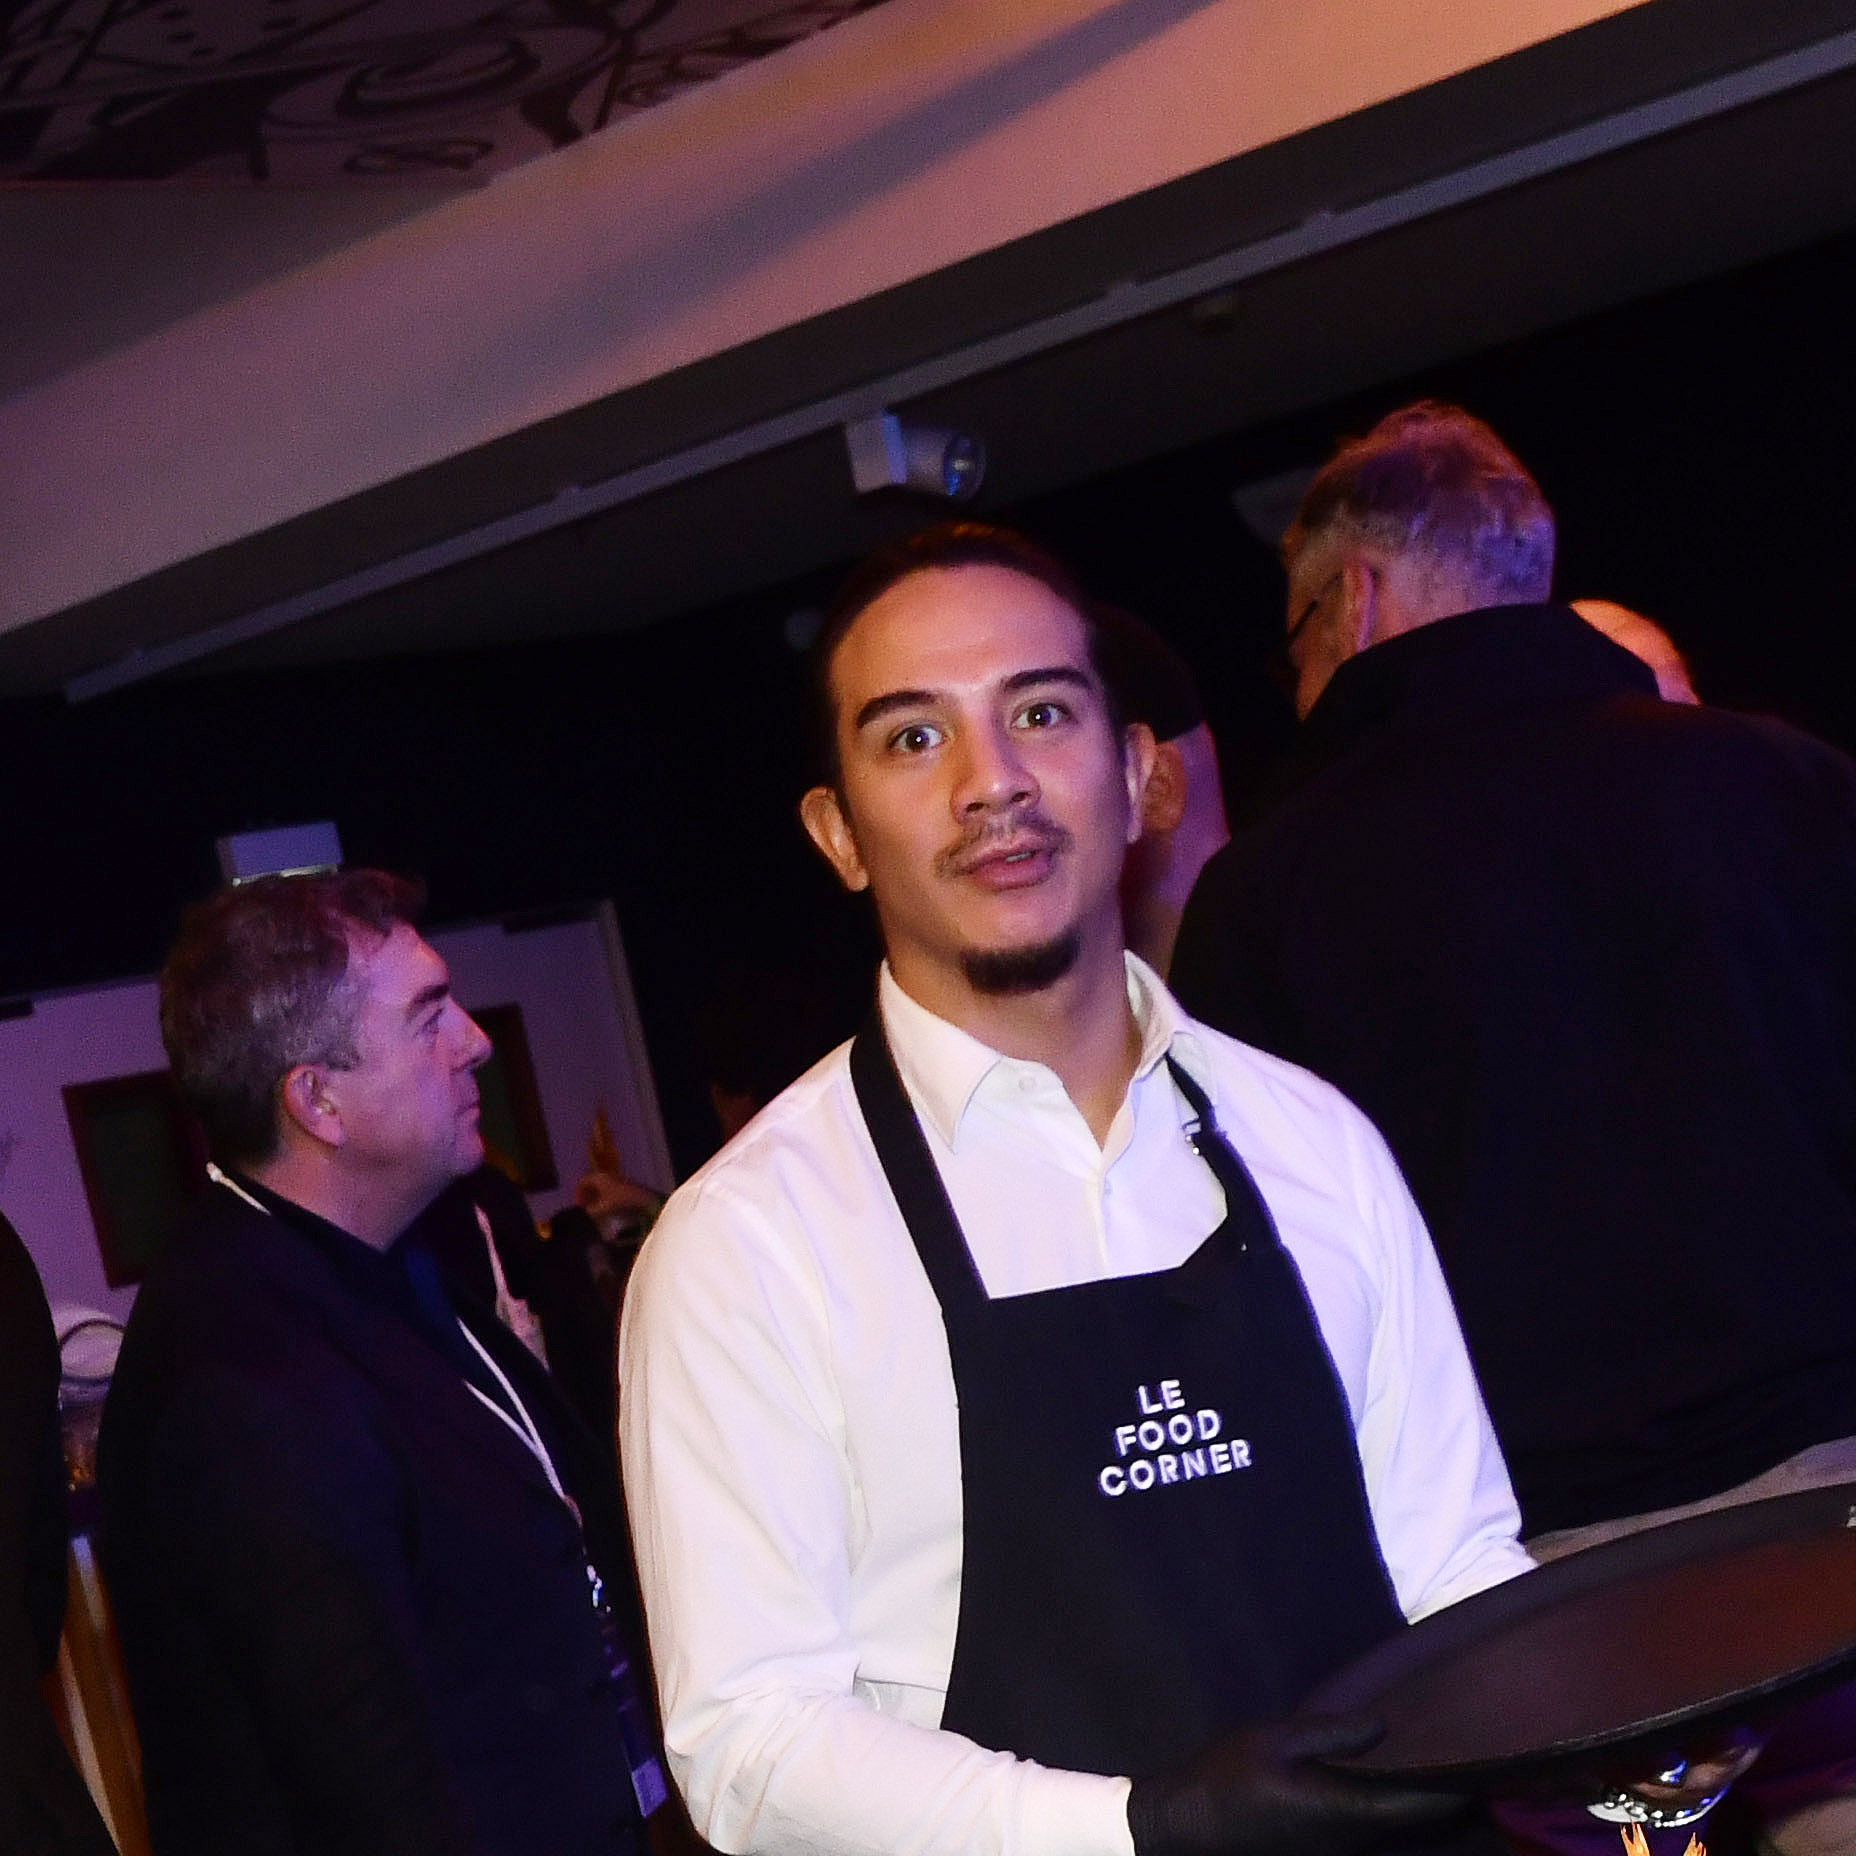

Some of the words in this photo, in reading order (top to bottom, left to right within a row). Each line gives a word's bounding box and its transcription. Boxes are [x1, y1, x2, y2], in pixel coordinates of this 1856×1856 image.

[1137, 1379, 1186, 1415] LE
[1114, 1408, 1223, 1457] FOOD
[1098, 1438, 1254, 1498] CORNER
